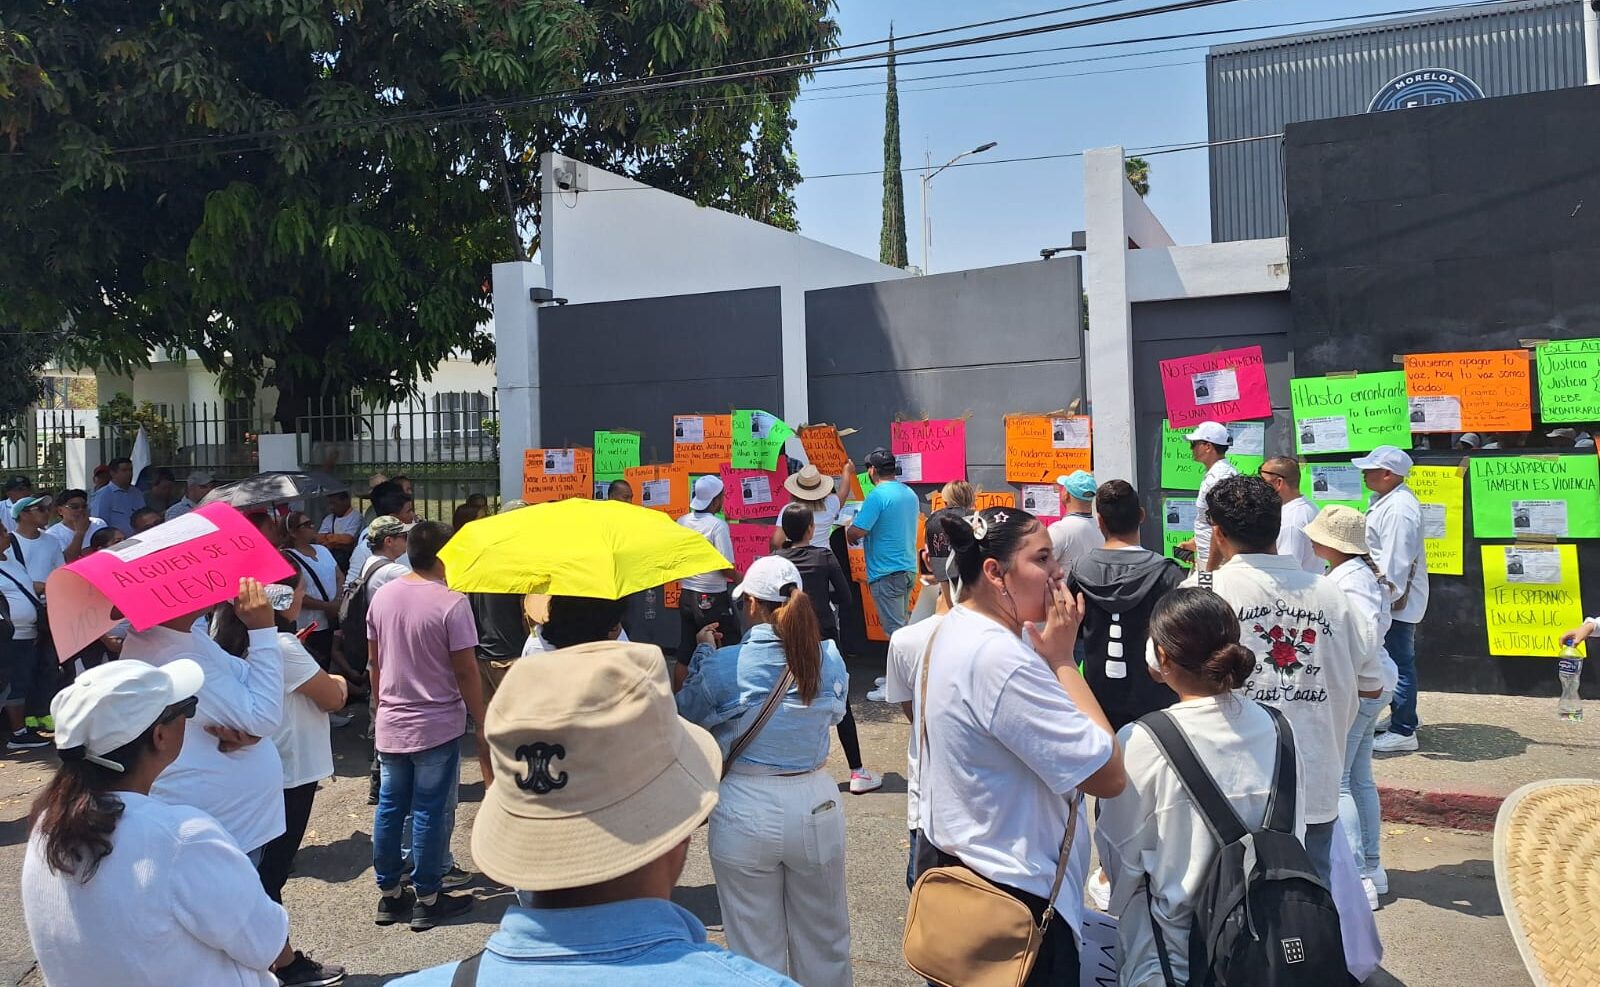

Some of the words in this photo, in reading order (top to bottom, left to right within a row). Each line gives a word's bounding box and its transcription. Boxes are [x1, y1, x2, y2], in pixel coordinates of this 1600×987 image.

[1395, 73, 1455, 90] MORELOS
[1162, 362, 1180, 379] NO
[1183, 362, 1199, 376] ES
[1203, 359, 1219, 372] UN
[1554, 393, 1583, 403] DEBE
[1211, 402, 1241, 416] VIDA
[918, 440, 945, 452] CASA
[1475, 461, 1494, 478] LA
[1484, 478, 1529, 491] TAMBIEN
[1533, 478, 1550, 491] ES
[112, 551, 202, 588] ALGUIEN
[203, 545, 228, 559] SE
[231, 535, 255, 552] LO
[151, 570, 227, 608] LLEVO
[1490, 585, 1510, 605] TE
[1512, 588, 1575, 607] ESPERAMOS
[1238, 606, 1272, 622] Auto
[1275, 599, 1333, 637] Supply
[1494, 631, 1556, 652] #JUSTICIA
[1305, 663, 1321, 676] 87
[1244, 680, 1280, 702] East
[1279, 684, 1328, 702] Coast
